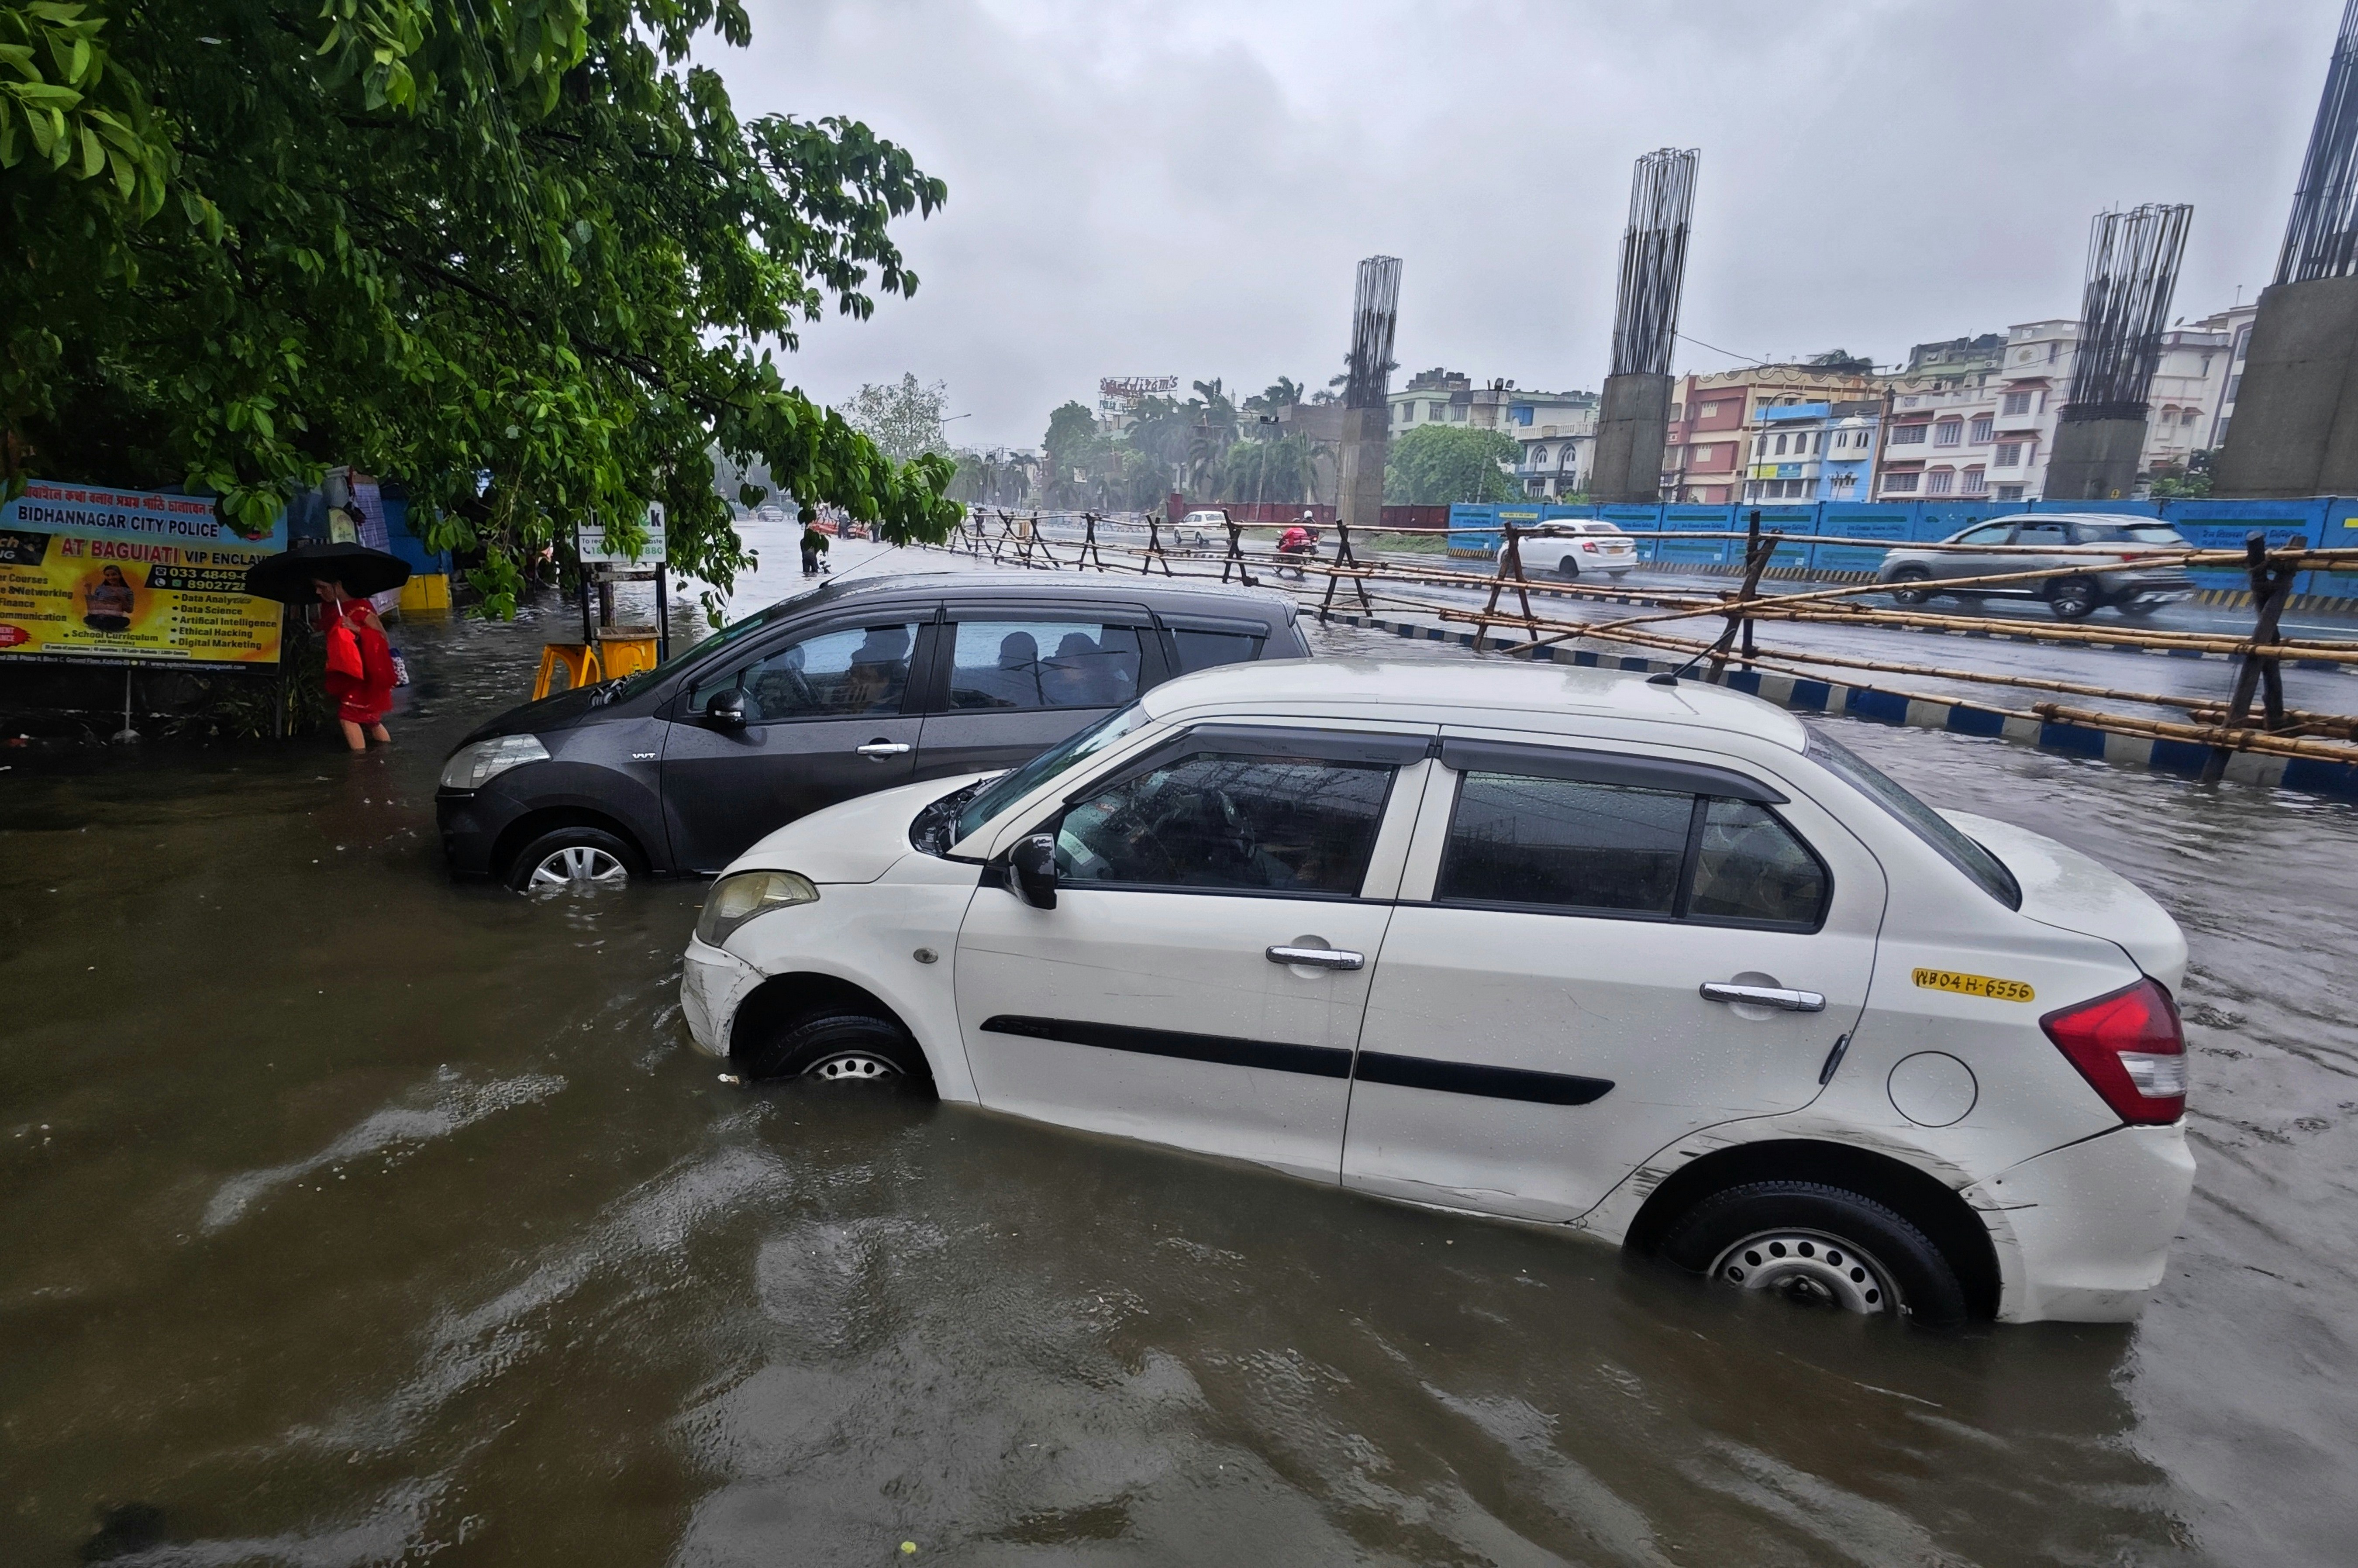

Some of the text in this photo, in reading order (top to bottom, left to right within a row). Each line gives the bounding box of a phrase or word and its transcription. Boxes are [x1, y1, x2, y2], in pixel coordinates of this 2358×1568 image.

[18, 505, 218, 538] BIDHANNAGAR CITY POLICE
[61, 538, 86, 556] AT
[91, 540, 179, 564] BAGUIATI
[184, 550, 207, 563] VIP
[9, 573, 48, 584] Courses
[169, 568, 197, 579] 033
[181, 593, 203, 602] Data
[181, 605, 243, 615] Data Science
[0, 611, 67, 622] ommunication
[221, 617, 277, 628] Intelligence
[71, 629, 159, 641] School Curriculum
[179, 627, 253, 639] Ethical Hacking
[178, 638, 262, 651] Digital Marketing
